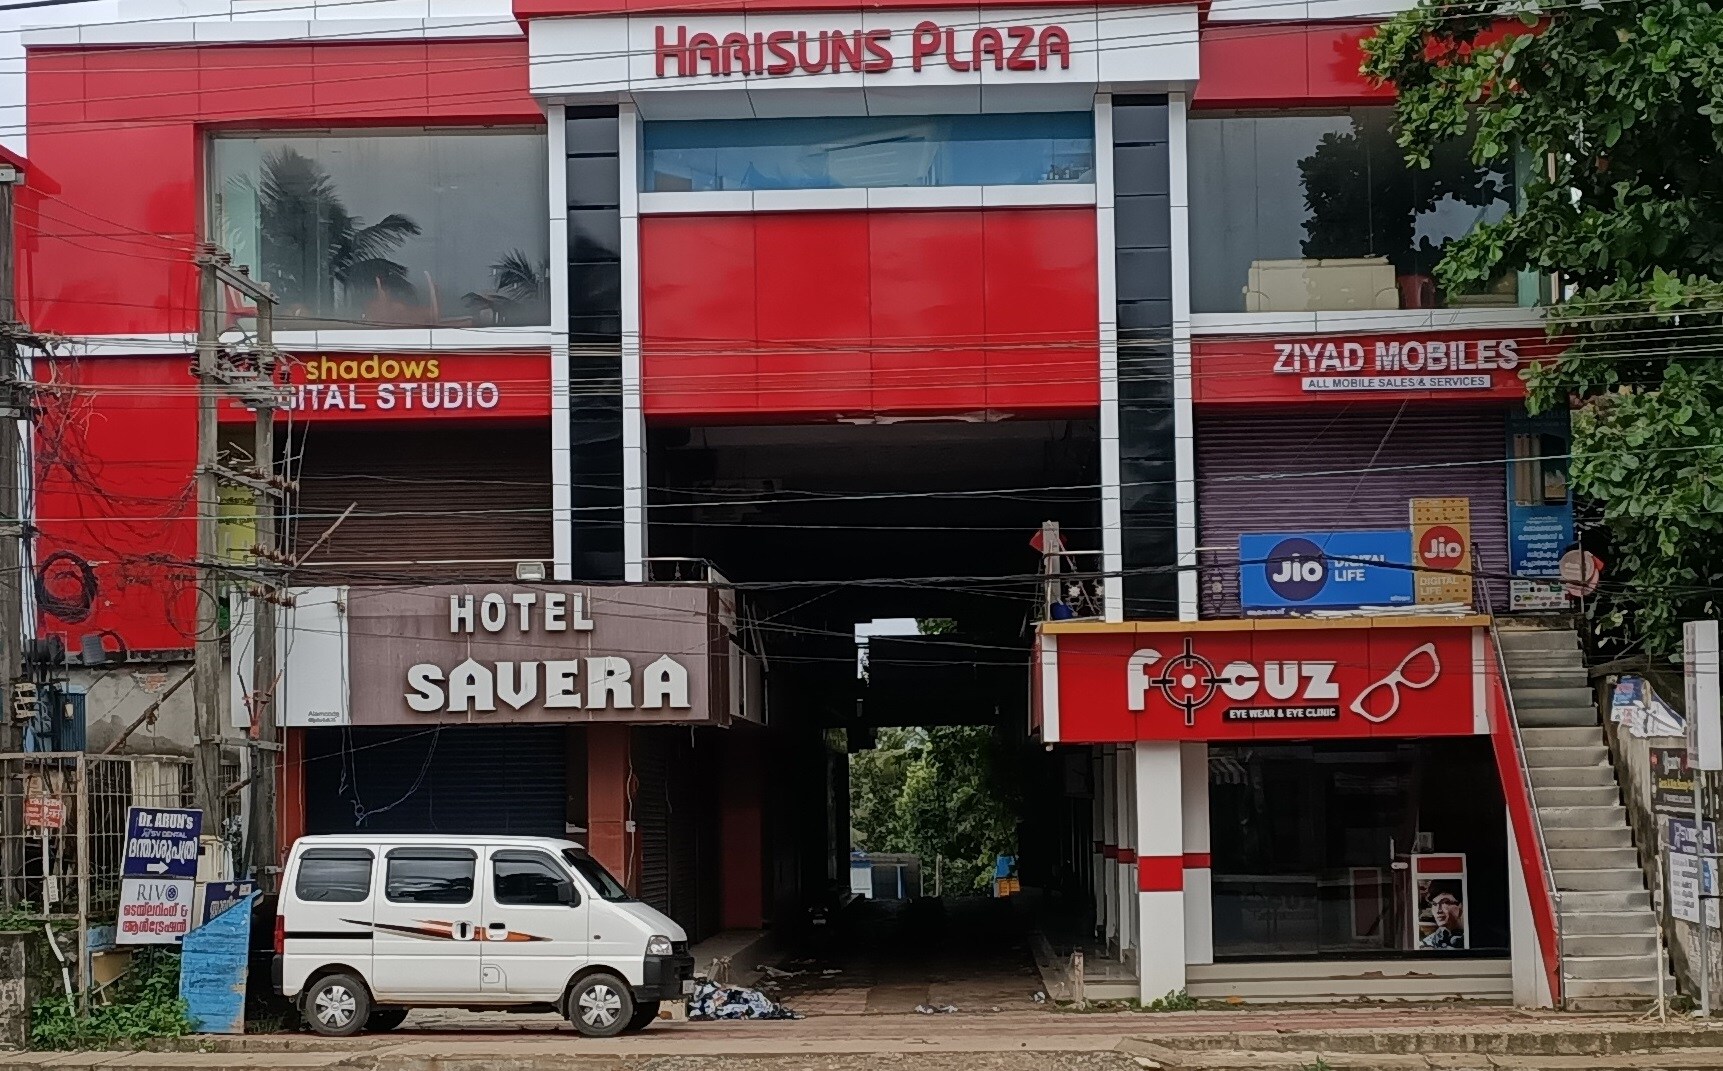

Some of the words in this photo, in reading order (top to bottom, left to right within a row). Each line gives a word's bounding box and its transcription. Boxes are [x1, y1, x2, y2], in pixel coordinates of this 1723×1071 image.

[655, 24, 893, 77] HARISUNS
[912, 20, 1070, 72] PLAZA
[1273, 342, 1365, 373] ZIYAD
[1375, 339, 1518, 371] MOBILES
[306, 355, 440, 380] shadows
[1308, 379, 1330, 388] ALL
[1332, 378, 1375, 388] MOBILE
[1378, 377, 1415, 388] SALES
[1417, 378, 1426, 387] &
[1429, 376, 1485, 387] SERVICES
[376, 381, 499, 410] STUDIO
[1424, 536, 1461, 558] Jio
[1272, 553, 1323, 582] Jio
[1334, 569, 1365, 581] LIFE
[1420, 577, 1459, 586] DIGITAL
[1421, 586, 1442, 596] LIFE
[450, 592, 594, 633] HOTEL
[404, 654, 691, 712] SAVERA
[1229, 709, 1248, 719] EYE
[1249, 709, 1275, 718] WEAR
[1277, 708, 1284, 718] &
[1286, 708, 1304, 718] EYE
[1305, 708, 1336, 717] CLINIC
[138, 812, 153, 827] Dr.
[180, 904, 189, 917] &
